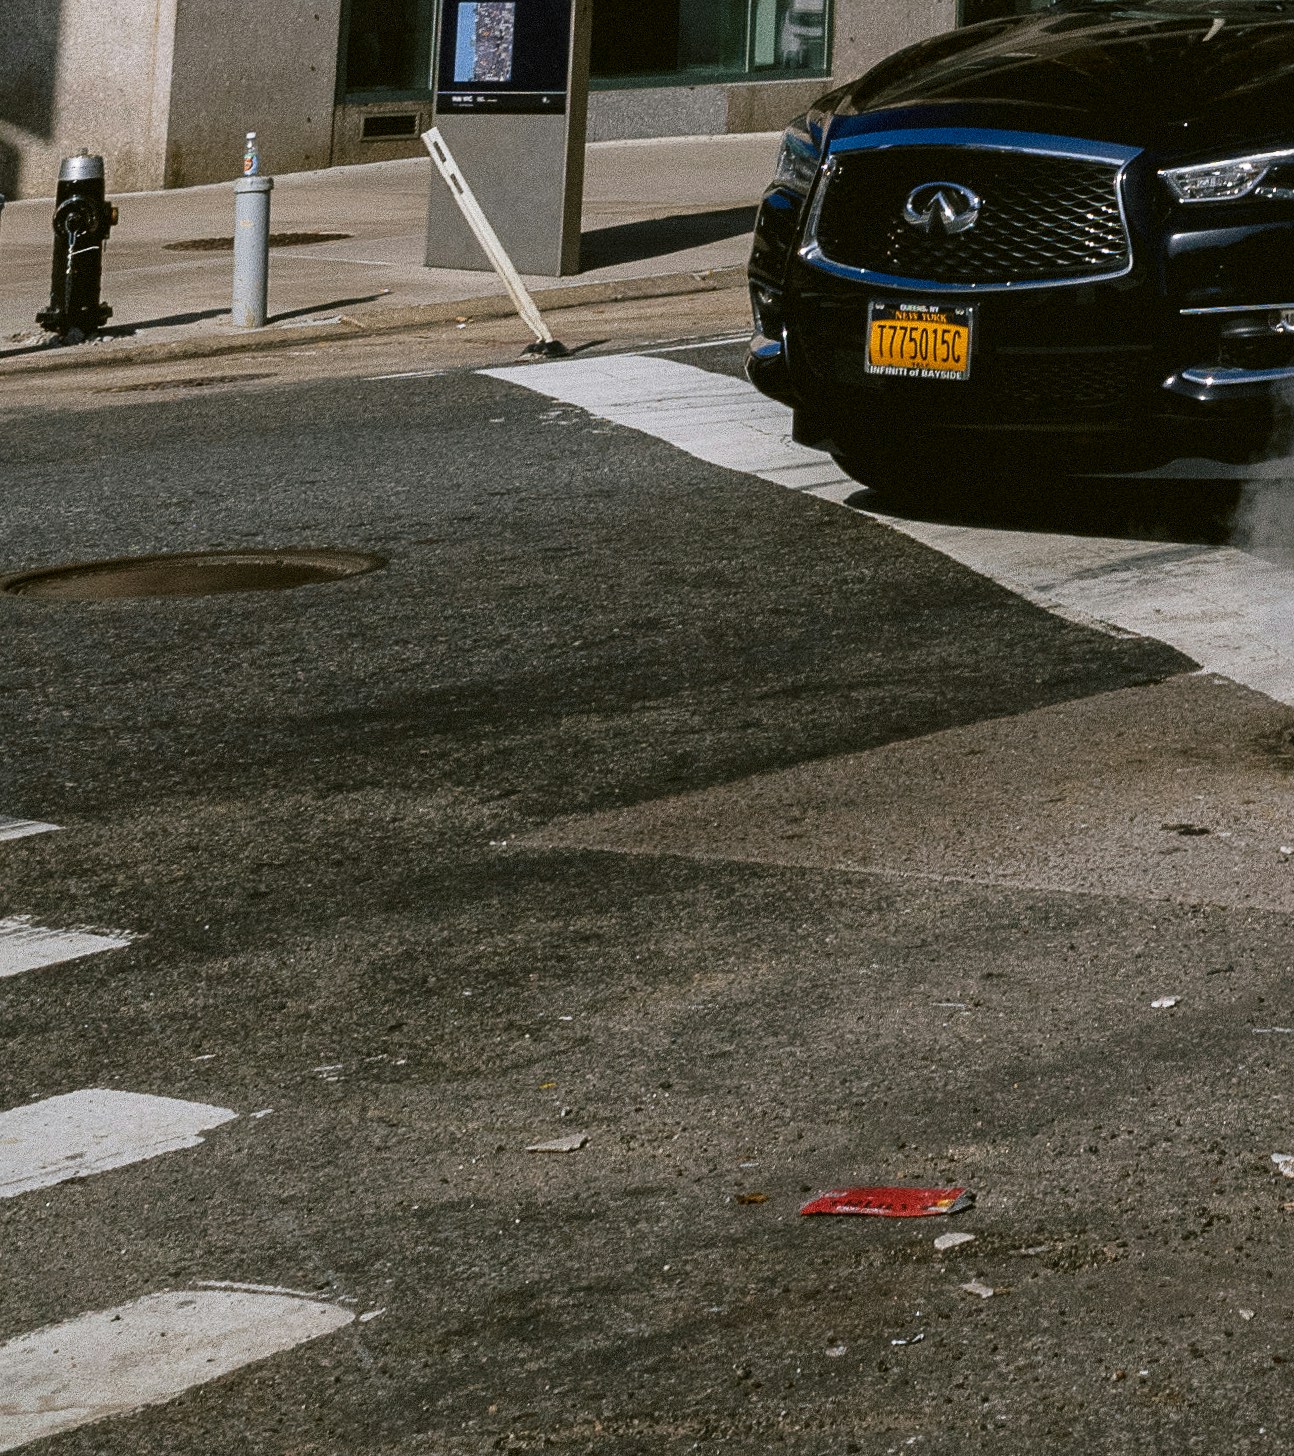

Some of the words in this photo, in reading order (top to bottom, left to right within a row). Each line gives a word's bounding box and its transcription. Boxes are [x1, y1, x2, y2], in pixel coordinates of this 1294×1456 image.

[895, 310, 919, 321] NEW
[921, 313, 947, 323] YORK
[878, 324, 962, 364] T775015C
[869, 365, 907, 376] INFINITI
[909, 368, 920, 377] of
[921, 370, 961, 380] BAYSIDE
